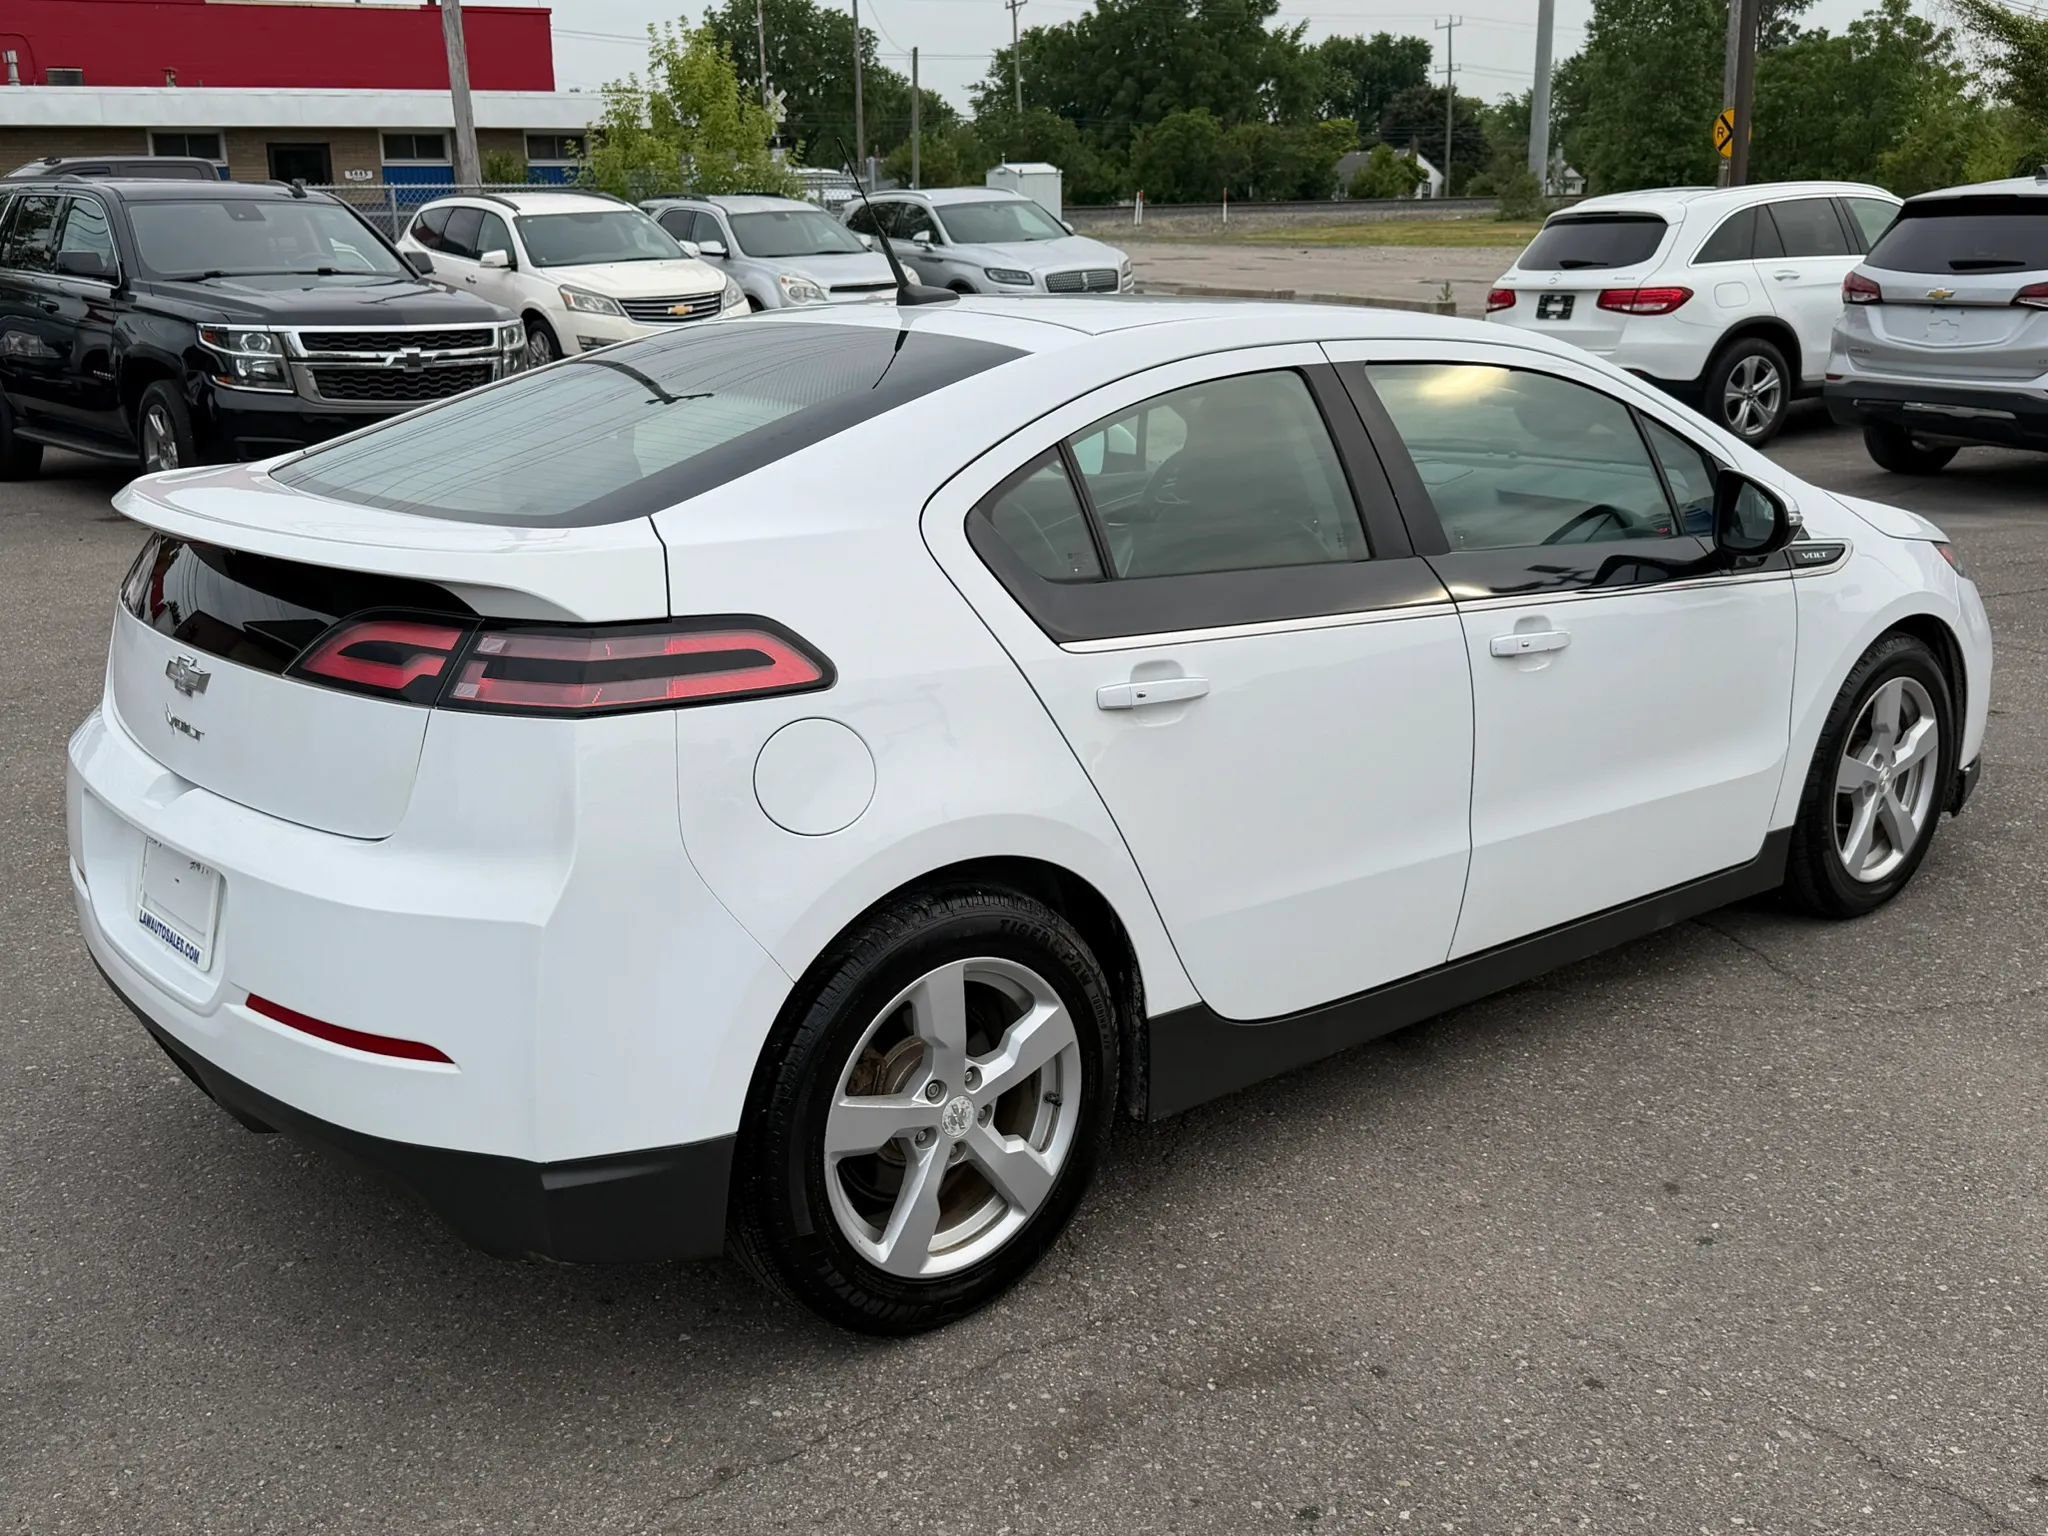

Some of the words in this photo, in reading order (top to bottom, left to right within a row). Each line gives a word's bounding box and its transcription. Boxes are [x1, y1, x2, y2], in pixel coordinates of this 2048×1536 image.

[1717, 126, 1725, 138] R
[1801, 551, 1827, 559] VOLT
[138, 908, 201, 965] LAWAUTOSALES.COM
[1000, 918, 1051, 944] TIGER
